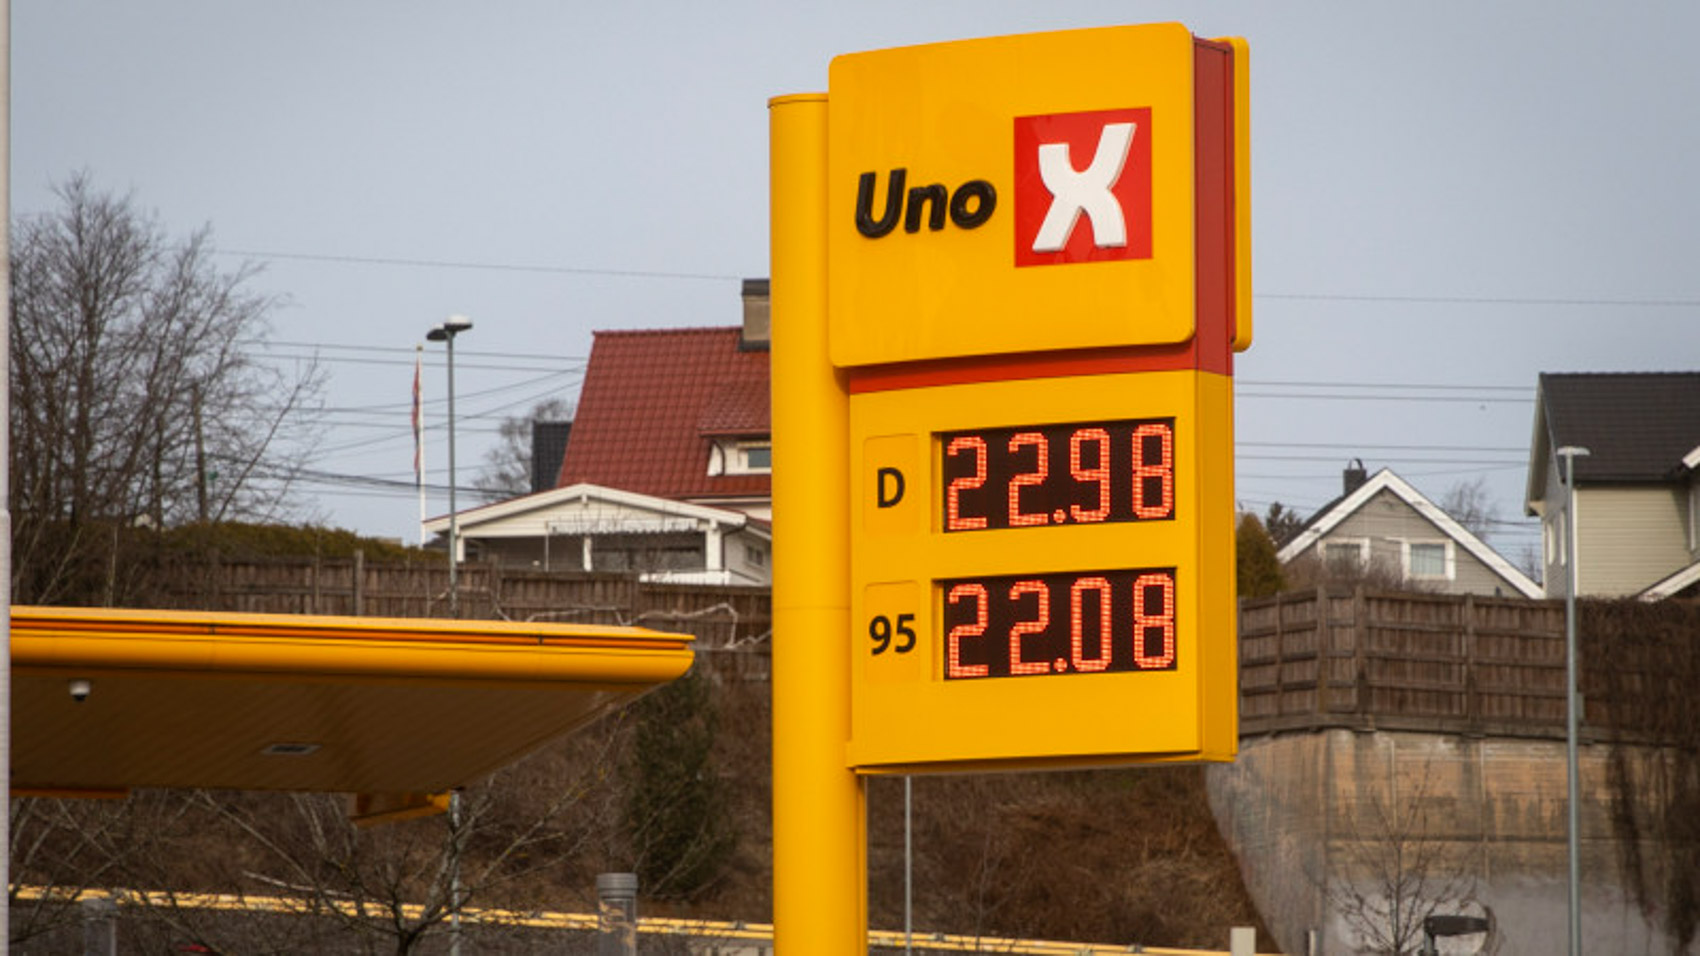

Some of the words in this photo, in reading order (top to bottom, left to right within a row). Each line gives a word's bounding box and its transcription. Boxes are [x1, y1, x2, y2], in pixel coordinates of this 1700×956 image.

[855, 168, 997, 239] Uno
[1032, 122, 1138, 252] X
[877, 467, 906, 508] D
[947, 424, 1174, 530] 22.98
[868, 613, 917, 656] 95
[949, 573, 1175, 678] 22.08
